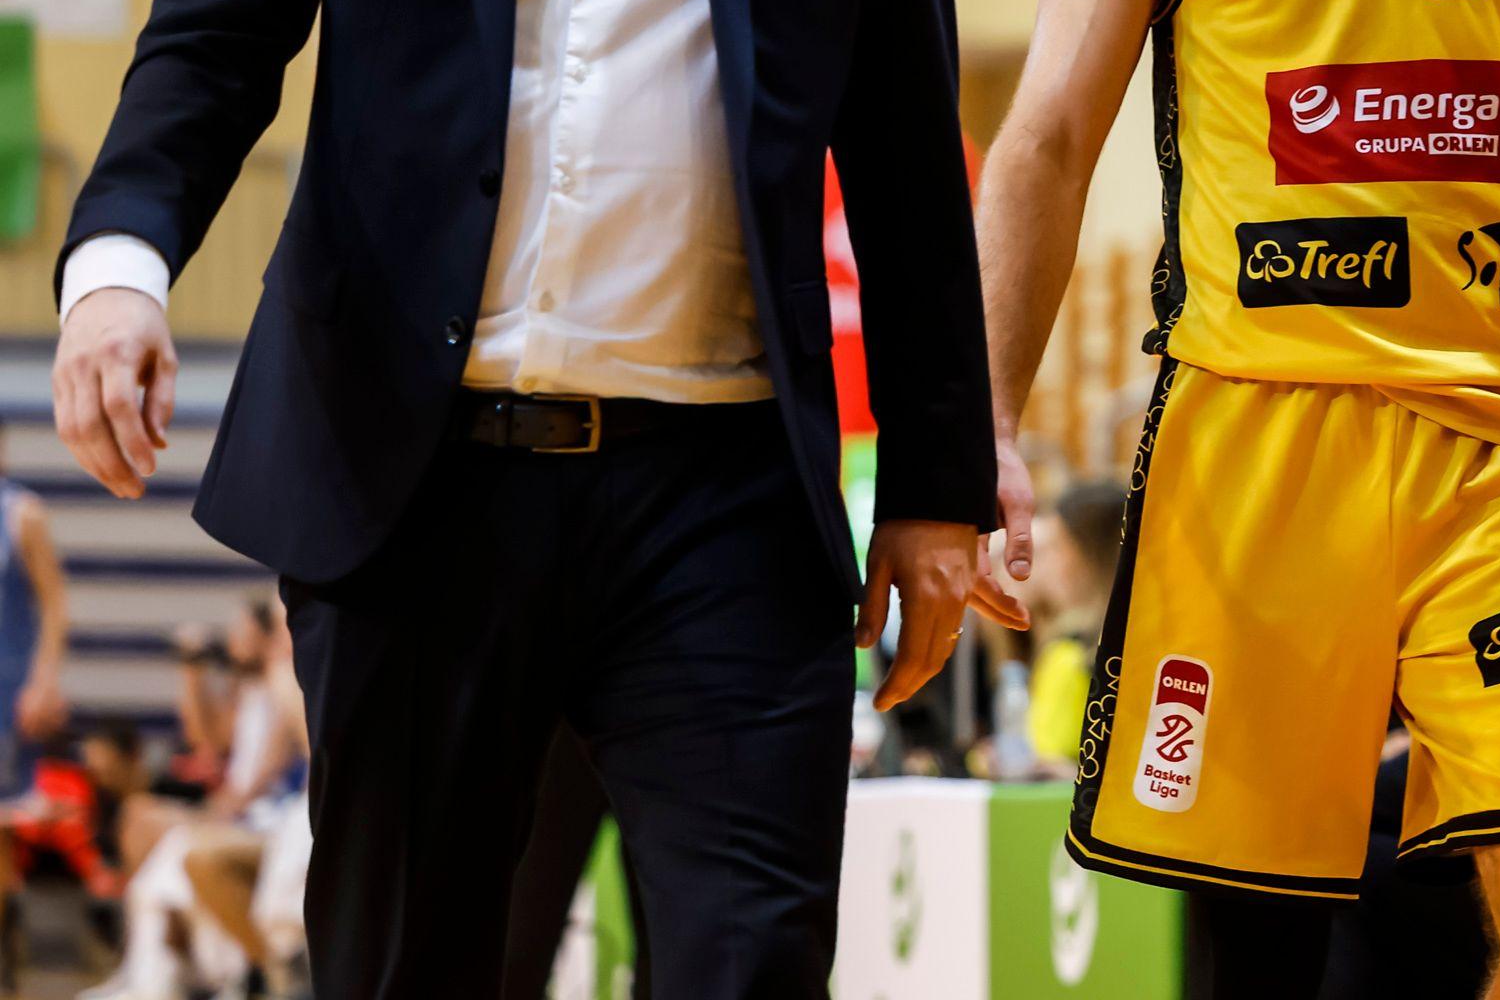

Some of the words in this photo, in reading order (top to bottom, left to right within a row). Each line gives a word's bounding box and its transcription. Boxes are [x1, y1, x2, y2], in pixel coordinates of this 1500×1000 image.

[1353, 87, 1500, 130] Energa
[1355, 137, 1426, 154] GRUPA
[1432, 136, 1496, 154] ORLEN
[1297, 240, 1398, 289] Trefl
[1162, 676, 1206, 695] ORLEN
[1144, 764, 1191, 786] Basket
[1150, 780, 1179, 798] Liga
